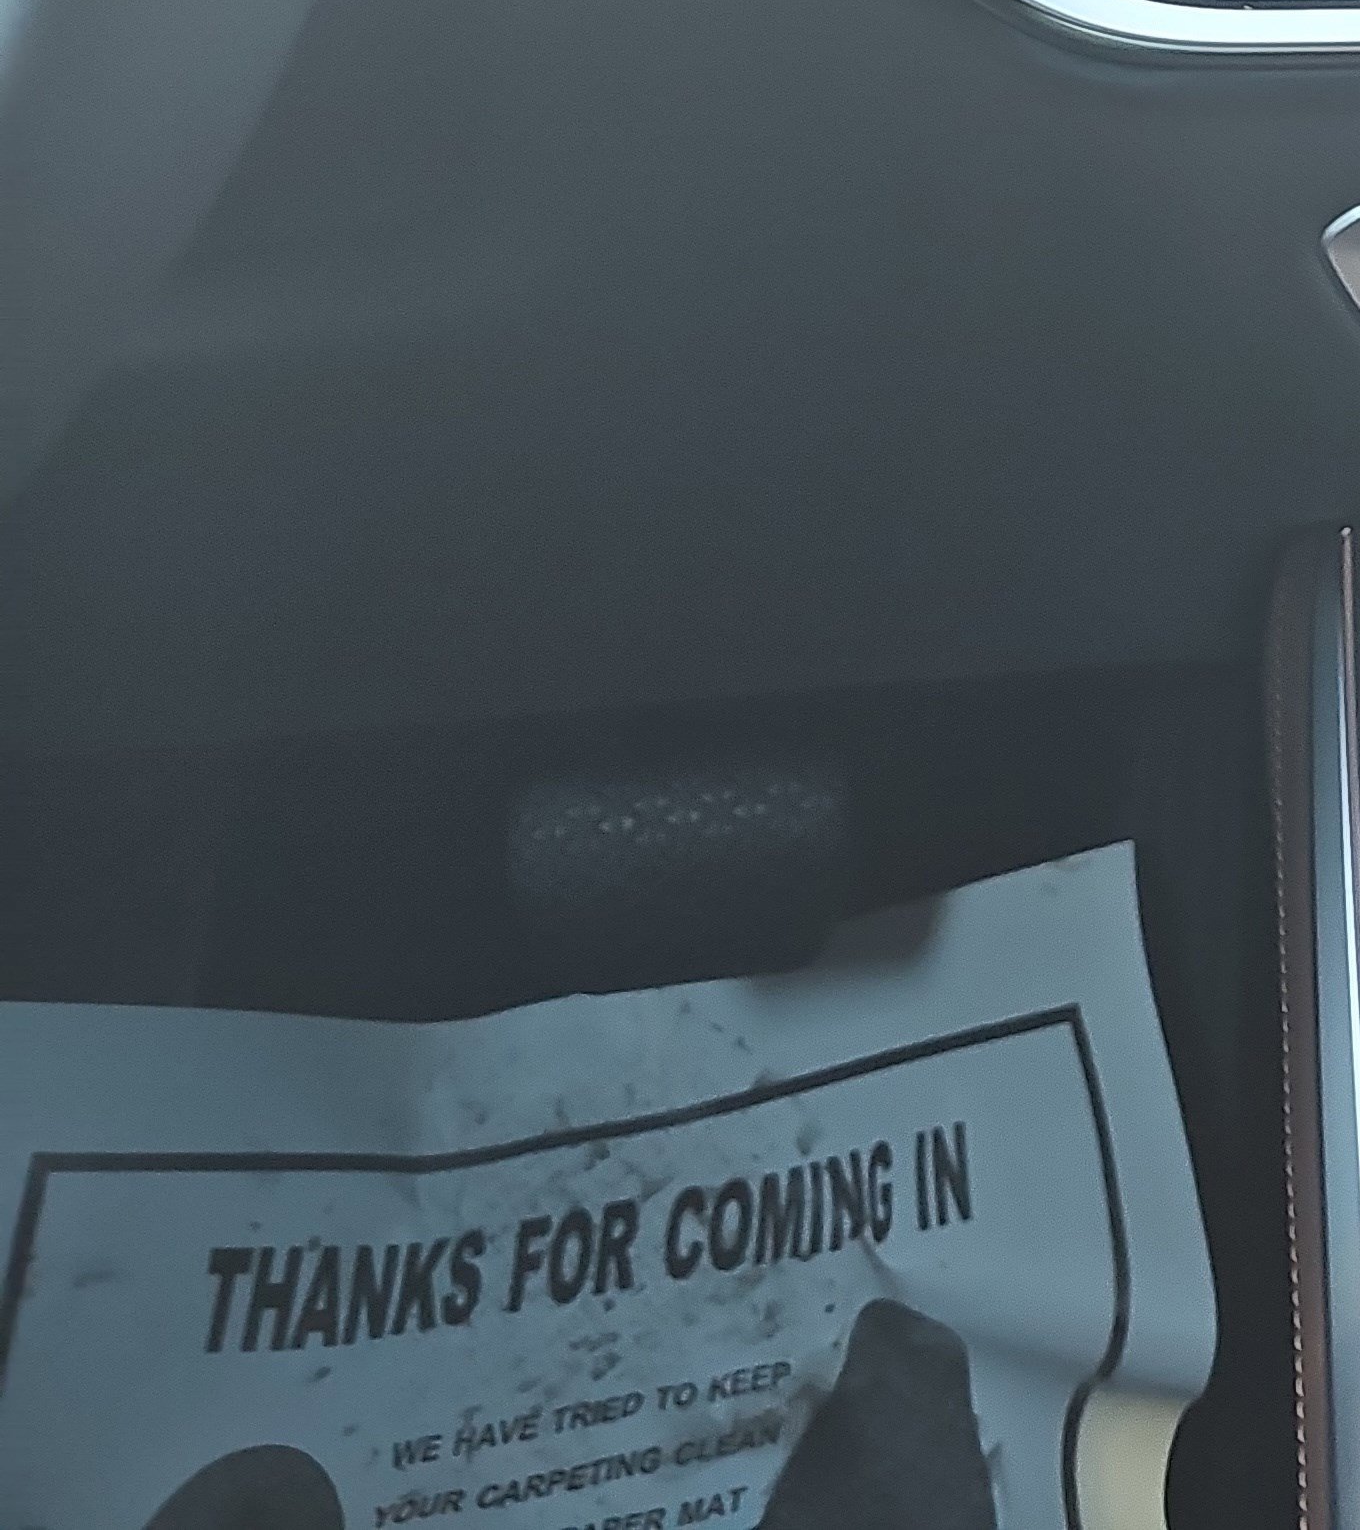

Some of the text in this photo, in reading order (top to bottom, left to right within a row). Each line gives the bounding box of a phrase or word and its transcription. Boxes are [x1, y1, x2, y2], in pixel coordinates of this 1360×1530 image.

[205, 1121, 973, 1354] THANKS FOR COMING IN
[391, 1360, 793, 1470] WE HAVE TRIED TO KEEP
[374, 1420, 784, 1529] YOUR CARPETING CLEAN
[562, 1485, 749, 1530] PER MAT
